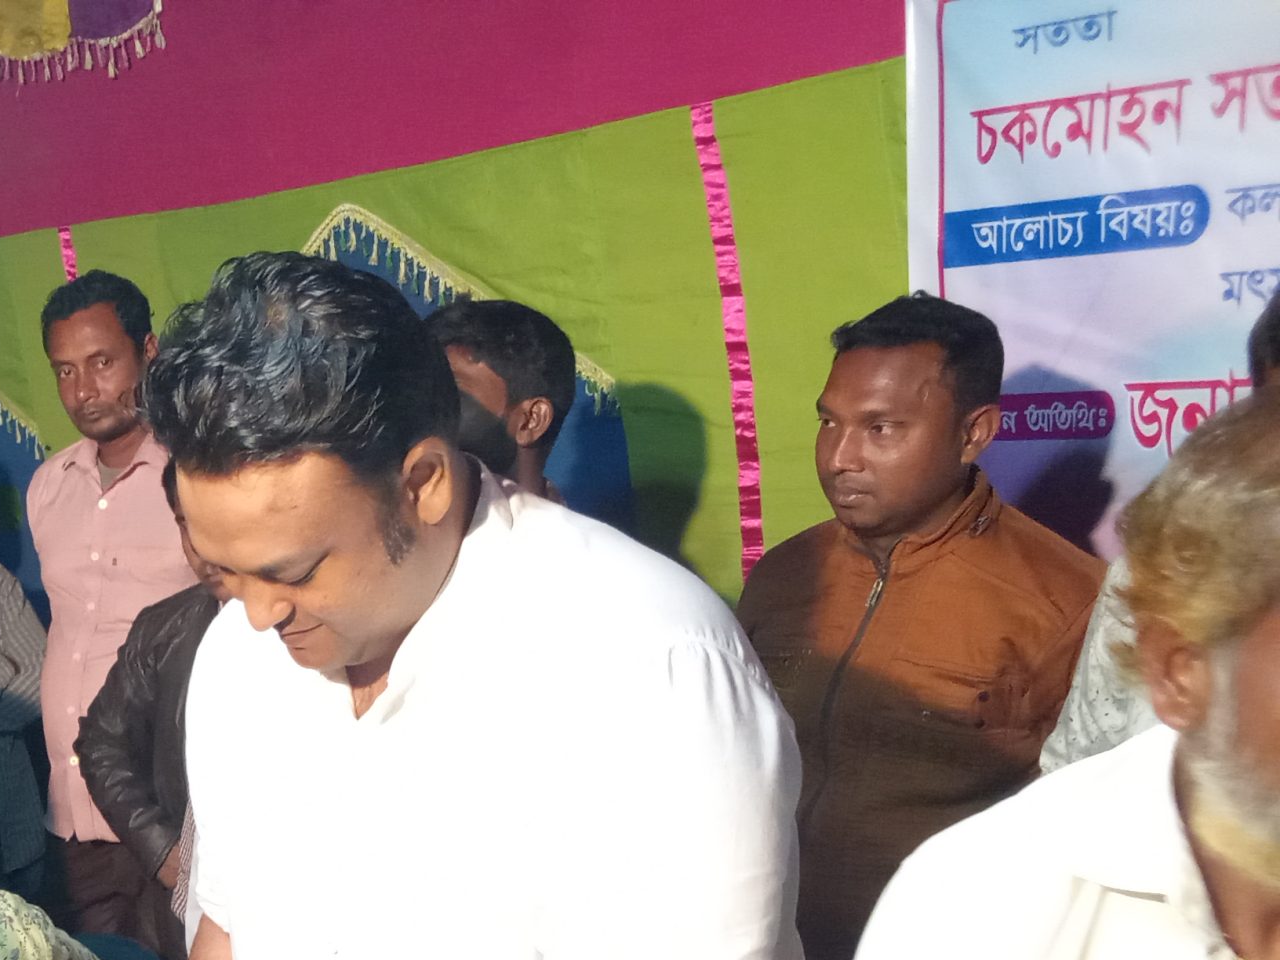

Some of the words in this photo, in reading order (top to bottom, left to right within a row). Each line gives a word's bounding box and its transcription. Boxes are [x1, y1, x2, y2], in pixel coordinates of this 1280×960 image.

[1013, 10, 1118, 54] সততা
[970, 78, 1192, 164] চকমোহন
[972, 210, 1089, 254] আলোচ্য
